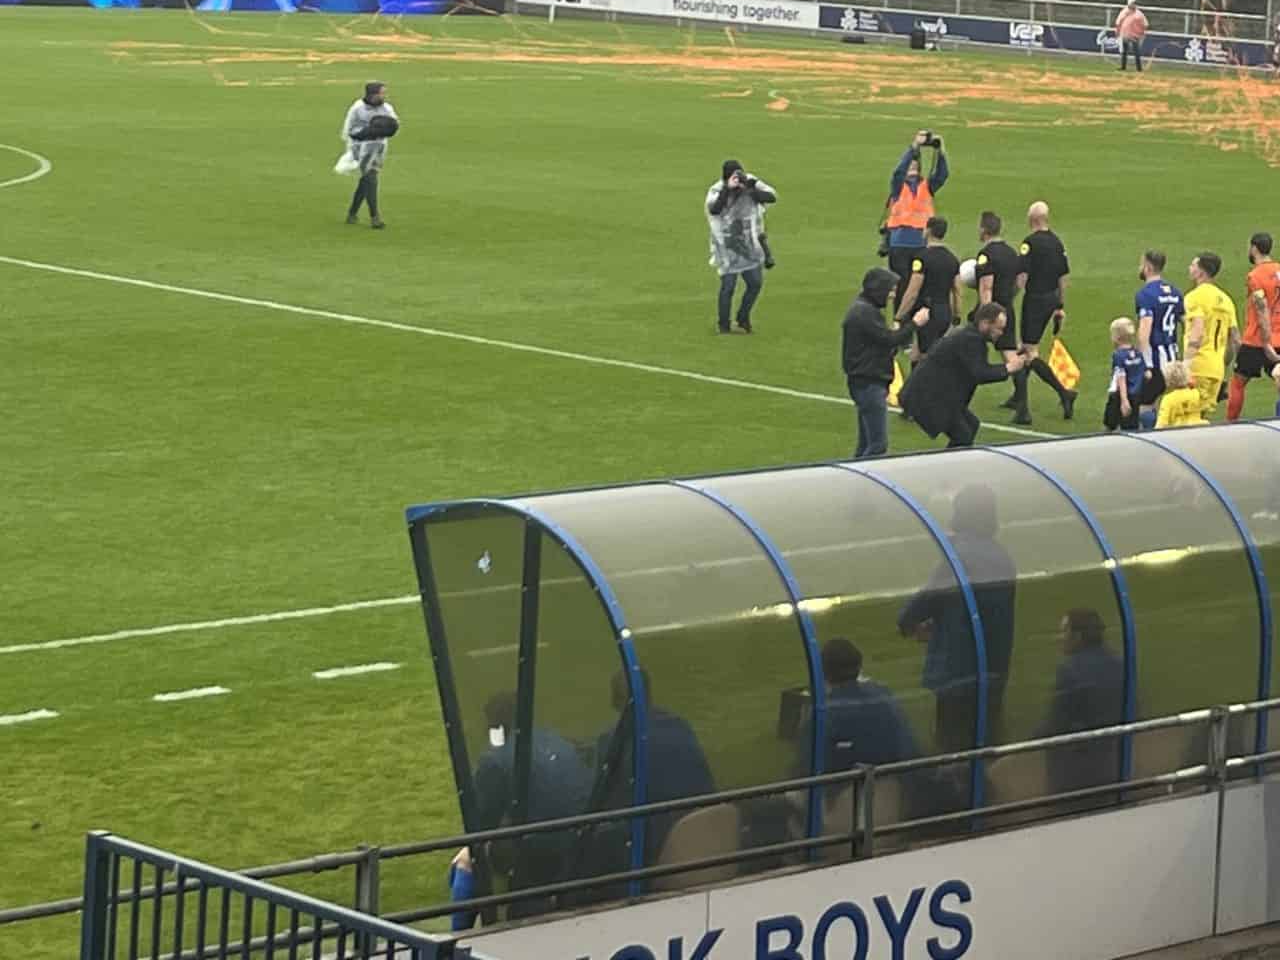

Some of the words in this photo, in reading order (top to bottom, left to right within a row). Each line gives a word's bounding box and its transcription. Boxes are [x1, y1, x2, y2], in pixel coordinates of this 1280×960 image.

[742, 4, 800, 22] together
[1162, 303, 1176, 337] 4
[1213, 319, 1222, 353] 1
[755, 880, 973, 960] BOYS
